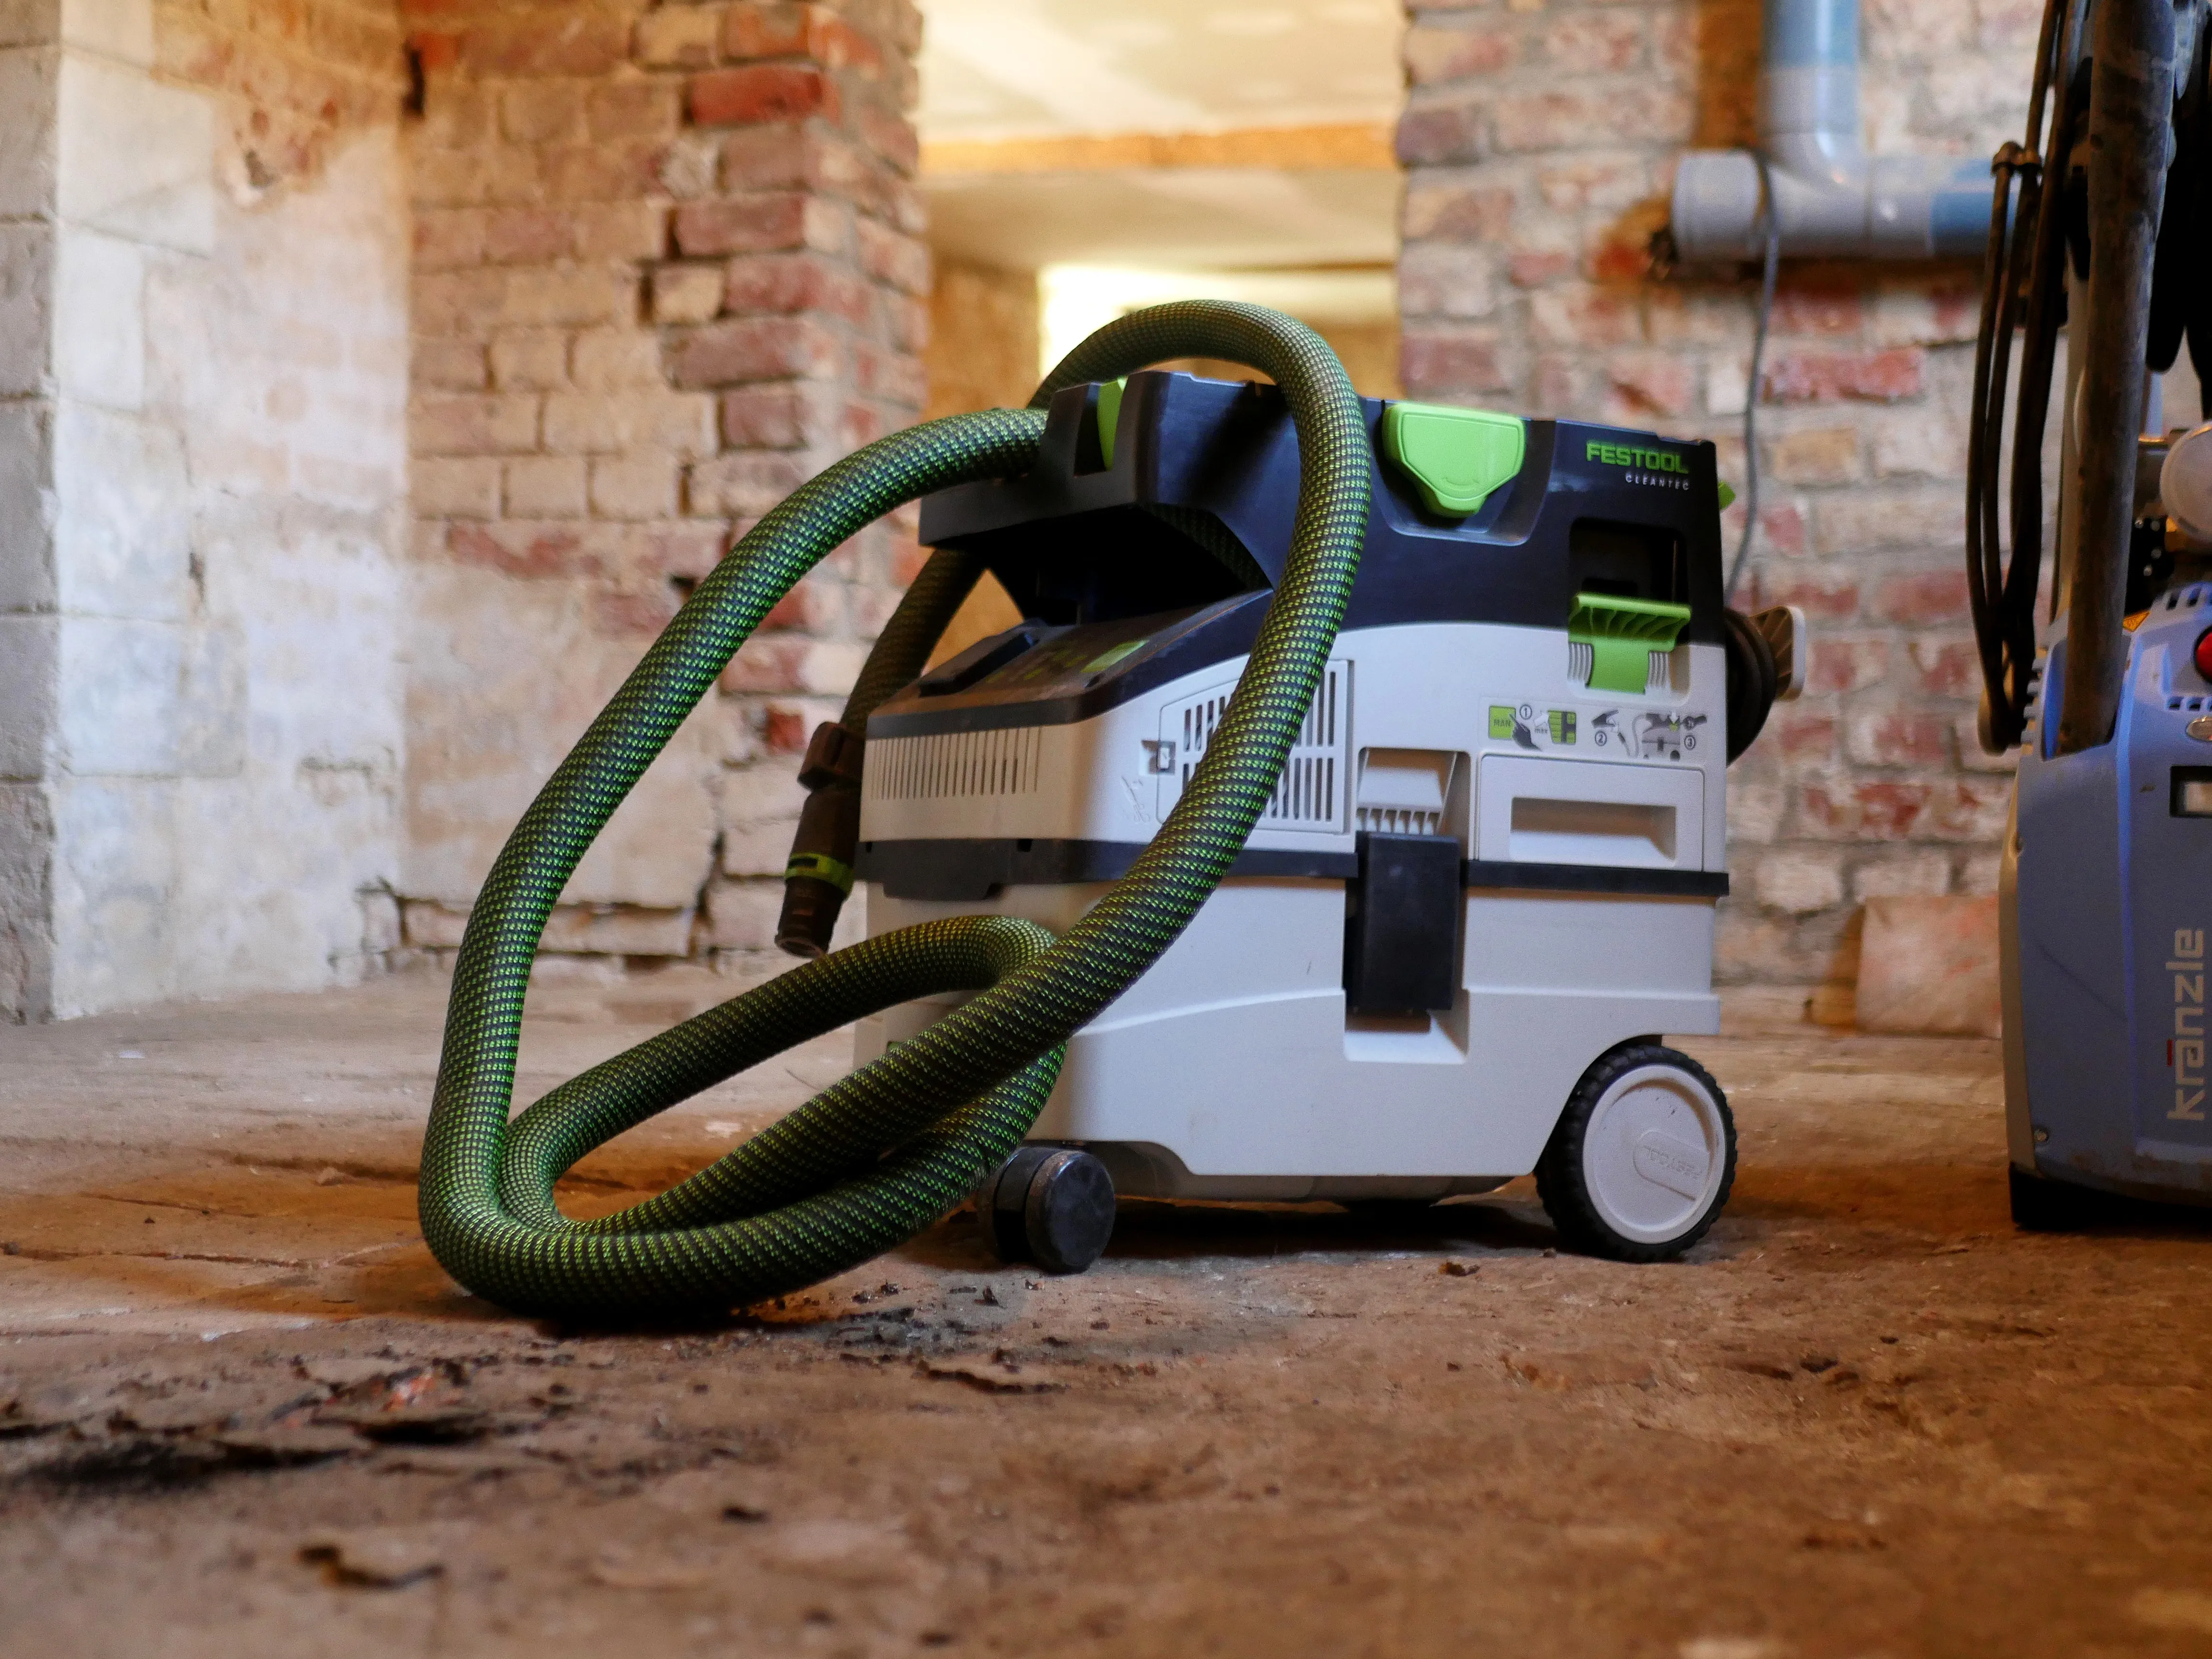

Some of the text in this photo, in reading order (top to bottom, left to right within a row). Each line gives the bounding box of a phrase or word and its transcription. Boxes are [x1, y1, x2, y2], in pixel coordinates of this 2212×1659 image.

[1586, 442, 1689, 474] FESTOOL
[1625, 471, 1689, 491] CLEANTEC
[1493, 719, 1511, 727] MAN
